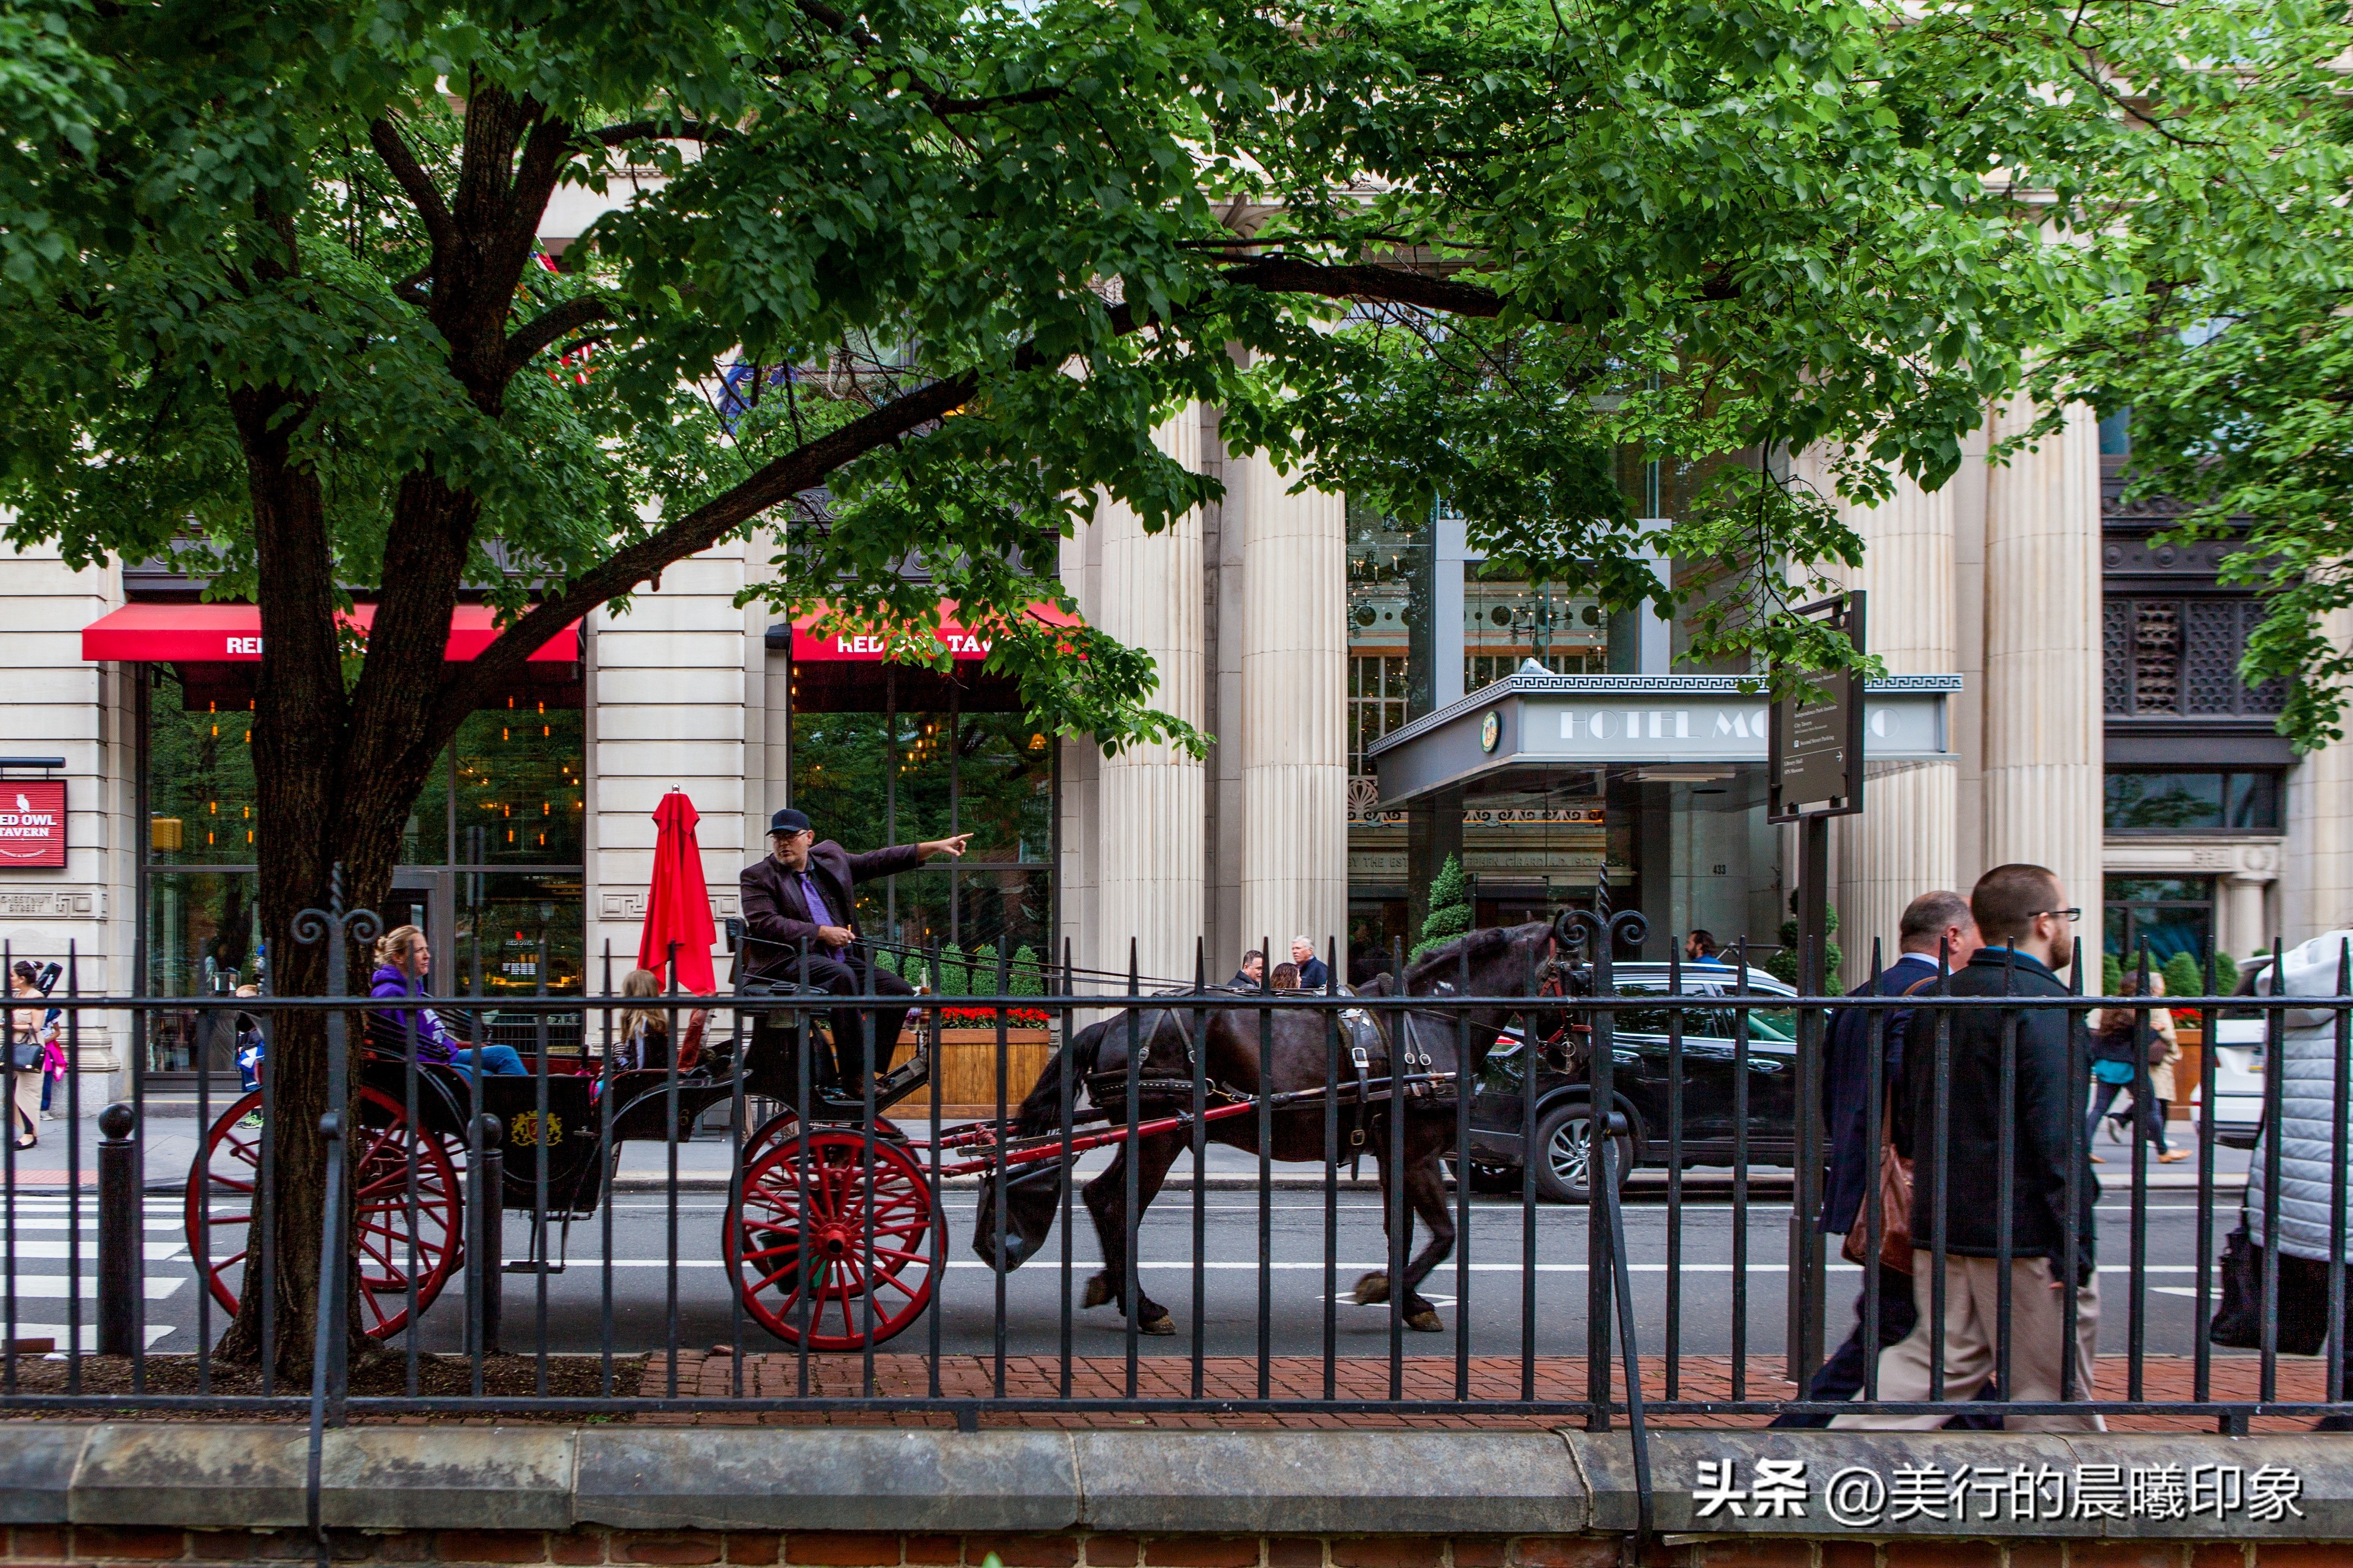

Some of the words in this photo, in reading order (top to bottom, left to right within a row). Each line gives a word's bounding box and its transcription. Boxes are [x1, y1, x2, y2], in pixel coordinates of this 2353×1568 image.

[838, 636, 884, 653] RED
[1560, 710, 1701, 739] HOTEL
[0, 815, 18, 825] ED
[21, 815, 57, 825] OWL
[0, 828, 49, 837] TAVERN
[1363, 858, 1383, 867] THE
[1463, 857, 1498, 866] TEPHEN
[1713, 864, 1726, 874] 433
[9, 904, 43, 912] STREET
